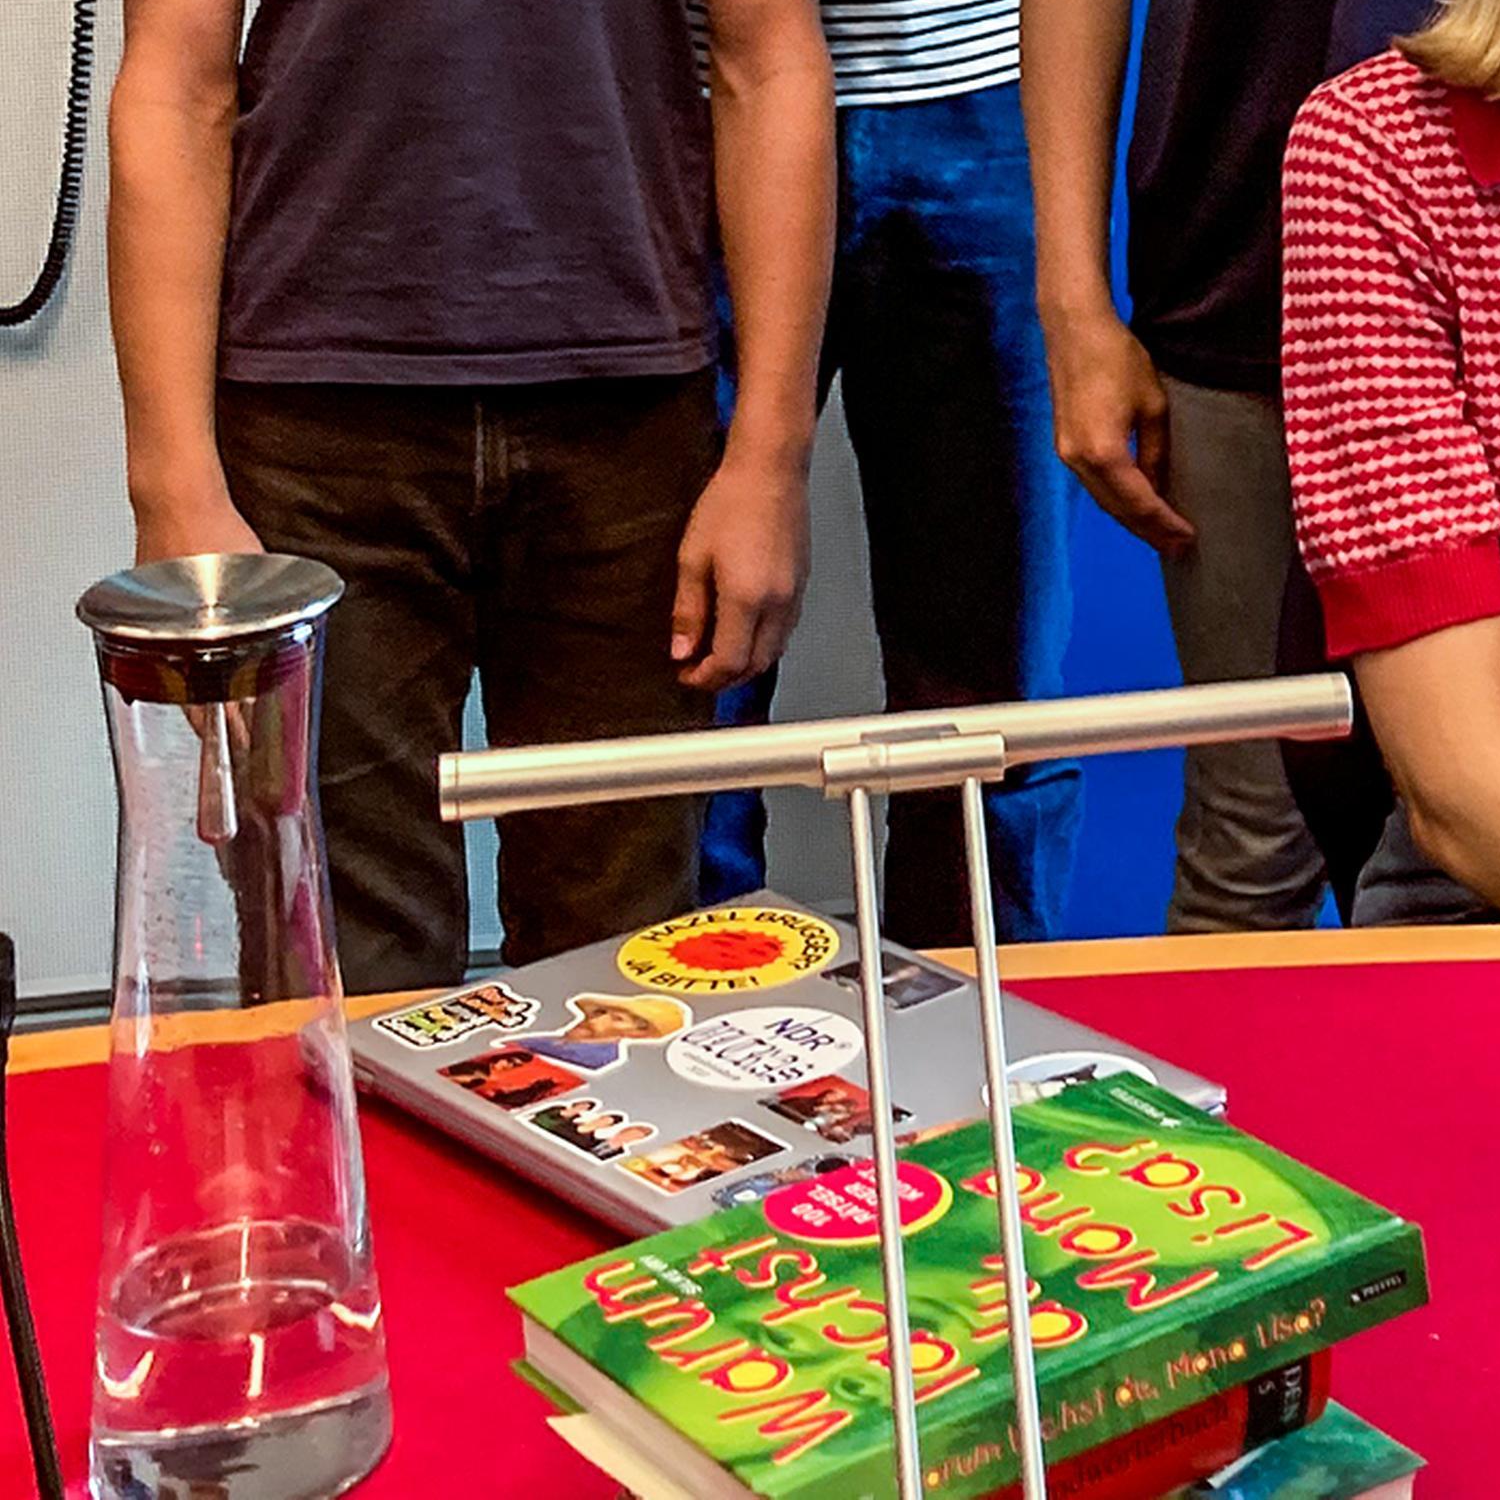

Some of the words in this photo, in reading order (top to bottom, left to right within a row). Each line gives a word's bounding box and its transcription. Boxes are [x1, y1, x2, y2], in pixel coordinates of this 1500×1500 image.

[763, 1017, 836, 1052] NDR
[790, 1202, 833, 1228] 100
[959, 1162, 1220, 1313] Mona
[1064, 1139, 1318, 1271] Lisa?
[583, 1258, 854, 1466] Warum
